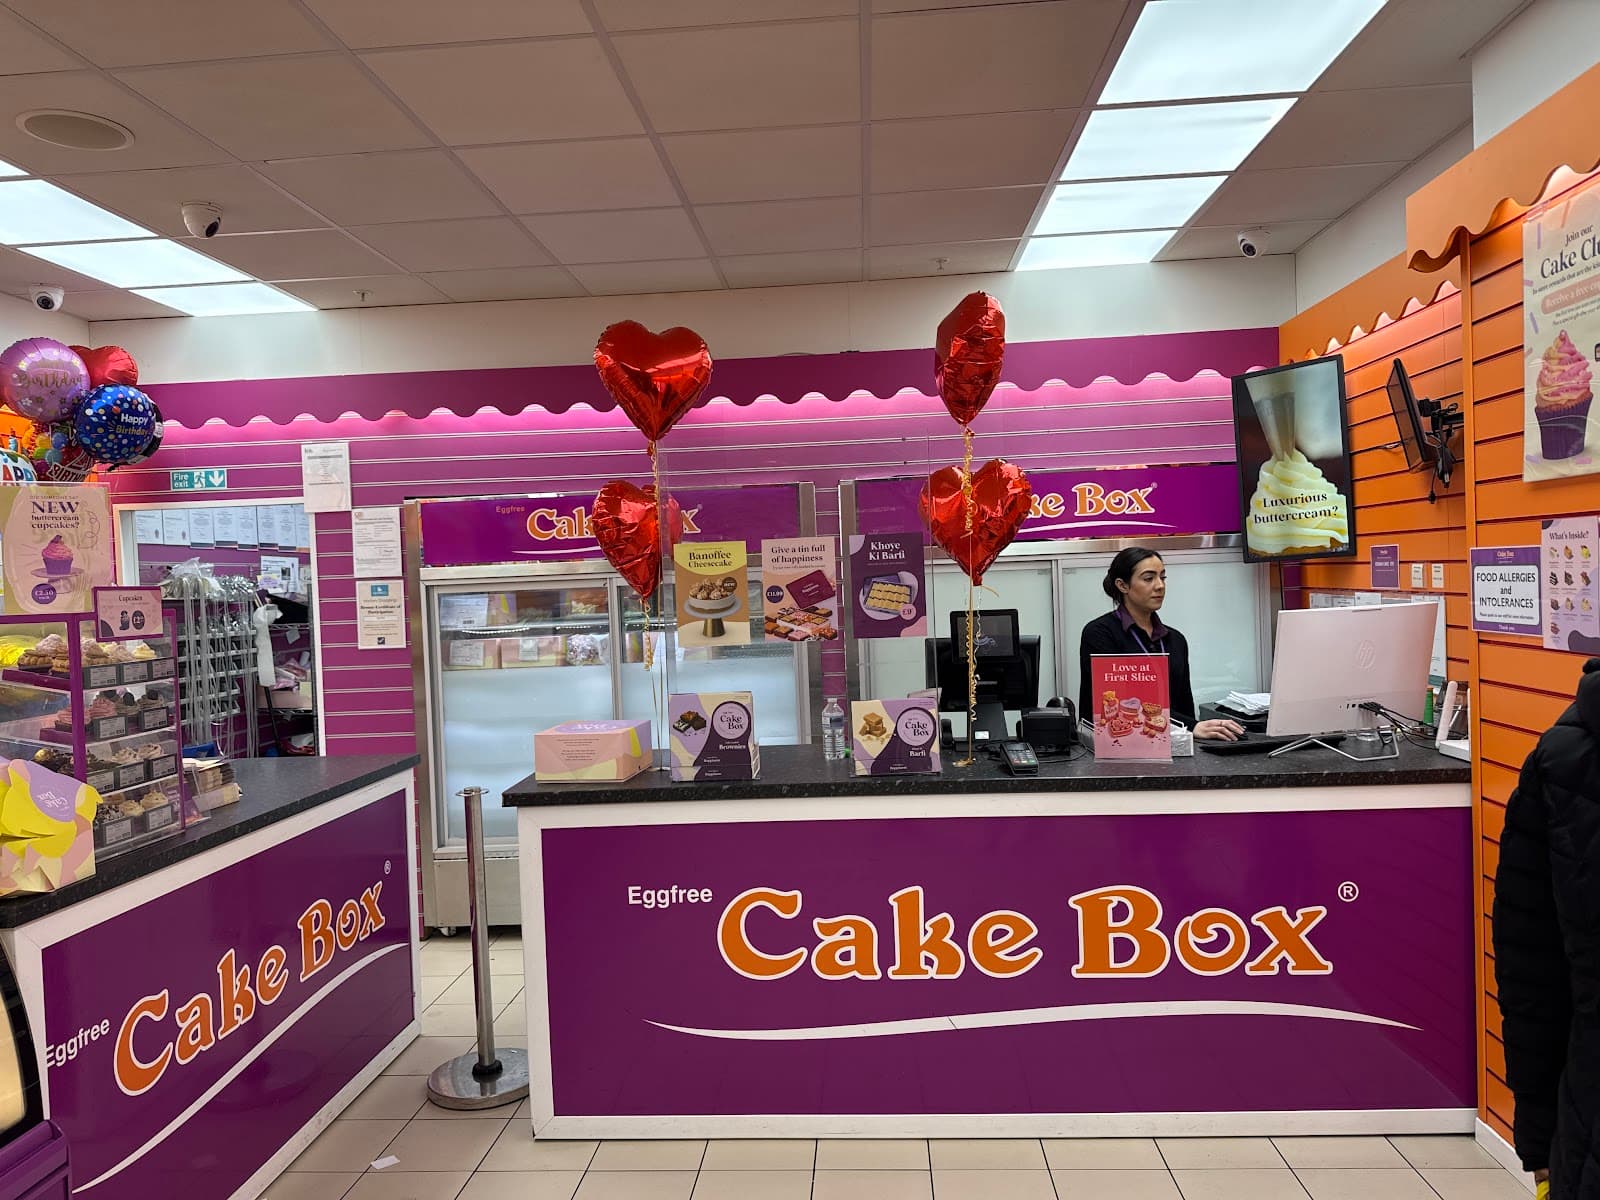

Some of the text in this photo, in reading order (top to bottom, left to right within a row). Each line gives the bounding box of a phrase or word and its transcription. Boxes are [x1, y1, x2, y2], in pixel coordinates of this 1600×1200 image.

[1565, 224, 1593, 247] Join our
[1540, 249, 1577, 279] Cake
[120, 412, 149, 426] Happy
[115, 424, 149, 437] Birthday
[173, 472, 189, 482] Fire
[174, 480, 189, 489] exit
[1072, 482, 1155, 516] Box
[1262, 492, 1328, 508] Luxurious
[31, 501, 79, 513] NEW
[495, 505, 525, 514] Eggfree
[1254, 505, 1339, 524] buttercream?
[31, 521, 80, 530] cupcakes?
[526, 506, 598, 541] Cak
[771, 546, 790, 554] Give
[798, 544, 810, 553] tin
[811, 543, 826, 552] full
[870, 541, 901, 552] Khoye
[688, 550, 732, 560] Banoffee
[771, 554, 823, 565] of happiness
[869, 551, 880, 561] Ki
[688, 559, 733, 569] Cheesecake
[1476, 572, 1536, 583] FOOD ALLERGIES
[1500, 585, 1512, 595] and
[1479, 596, 1534, 609] INTOLERANCES
[1112, 663, 1150, 672] Love at
[1104, 672, 1157, 682] First Slice
[720, 714, 743, 723] Cake
[728, 722, 744, 730] Box
[905, 721, 928, 730] Cake
[913, 729, 929, 737] Box
[627, 885, 713, 908] Eggfree
[717, 885, 1043, 981] Cake
[1067, 884, 1334, 979] Box
[45, 1018, 110, 1069] Eggfree
[113, 945, 289, 1097] Cake
[297, 880, 386, 983] Box
